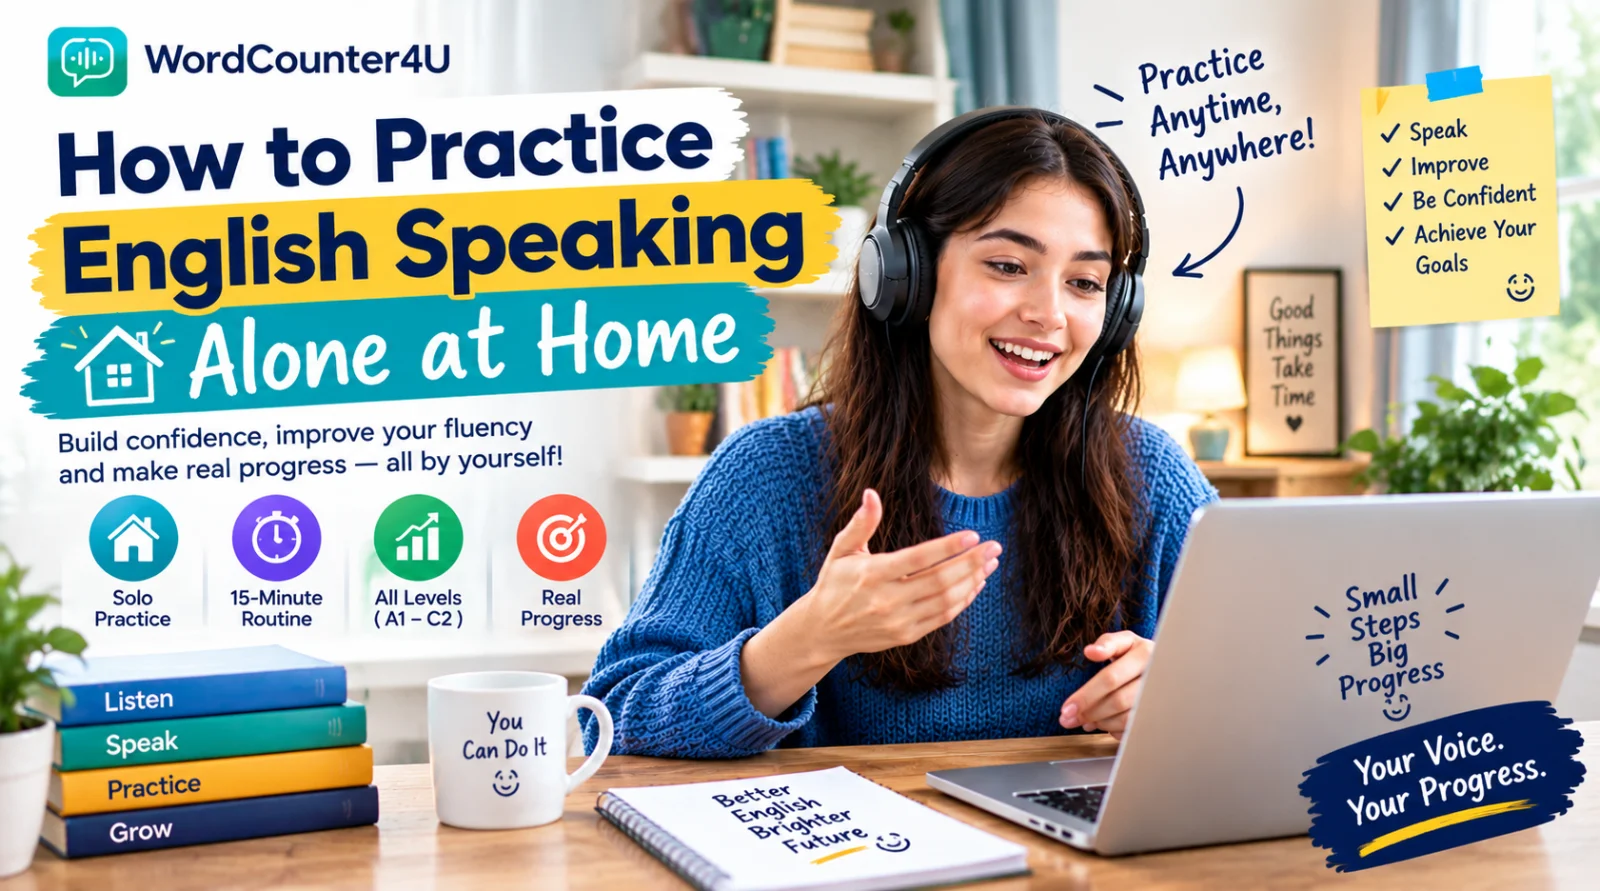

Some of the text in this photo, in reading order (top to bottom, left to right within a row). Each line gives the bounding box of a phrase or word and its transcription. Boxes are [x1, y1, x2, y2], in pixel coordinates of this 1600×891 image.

[1409, 117, 1468, 147] Speak
[1411, 156, 1490, 181] Improve
[1412, 182, 1537, 211] Be Confident
[1414, 218, 1537, 244] Achieve Your
[1415, 252, 1469, 275] Goals
[1269, 293, 1315, 322] Good
[1263, 326, 1323, 358] Things
[1272, 354, 1314, 379] Take
[1272, 383, 1315, 407] Time
[1345, 572, 1418, 613] Small
[1350, 611, 1421, 645] Steps
[1367, 639, 1409, 669] Big
[1338, 661, 1445, 700] Progress
[104, 690, 174, 712] Listen
[486, 710, 523, 735] You
[106, 729, 179, 760] Speak
[462, 736, 547, 760] Can Do It
[107, 774, 202, 801] Practice
[711, 785, 792, 808] Better
[730, 796, 823, 824] English
[109, 822, 173, 843] Grow
[747, 808, 852, 840] Brighter
[781, 827, 869, 854] Future
